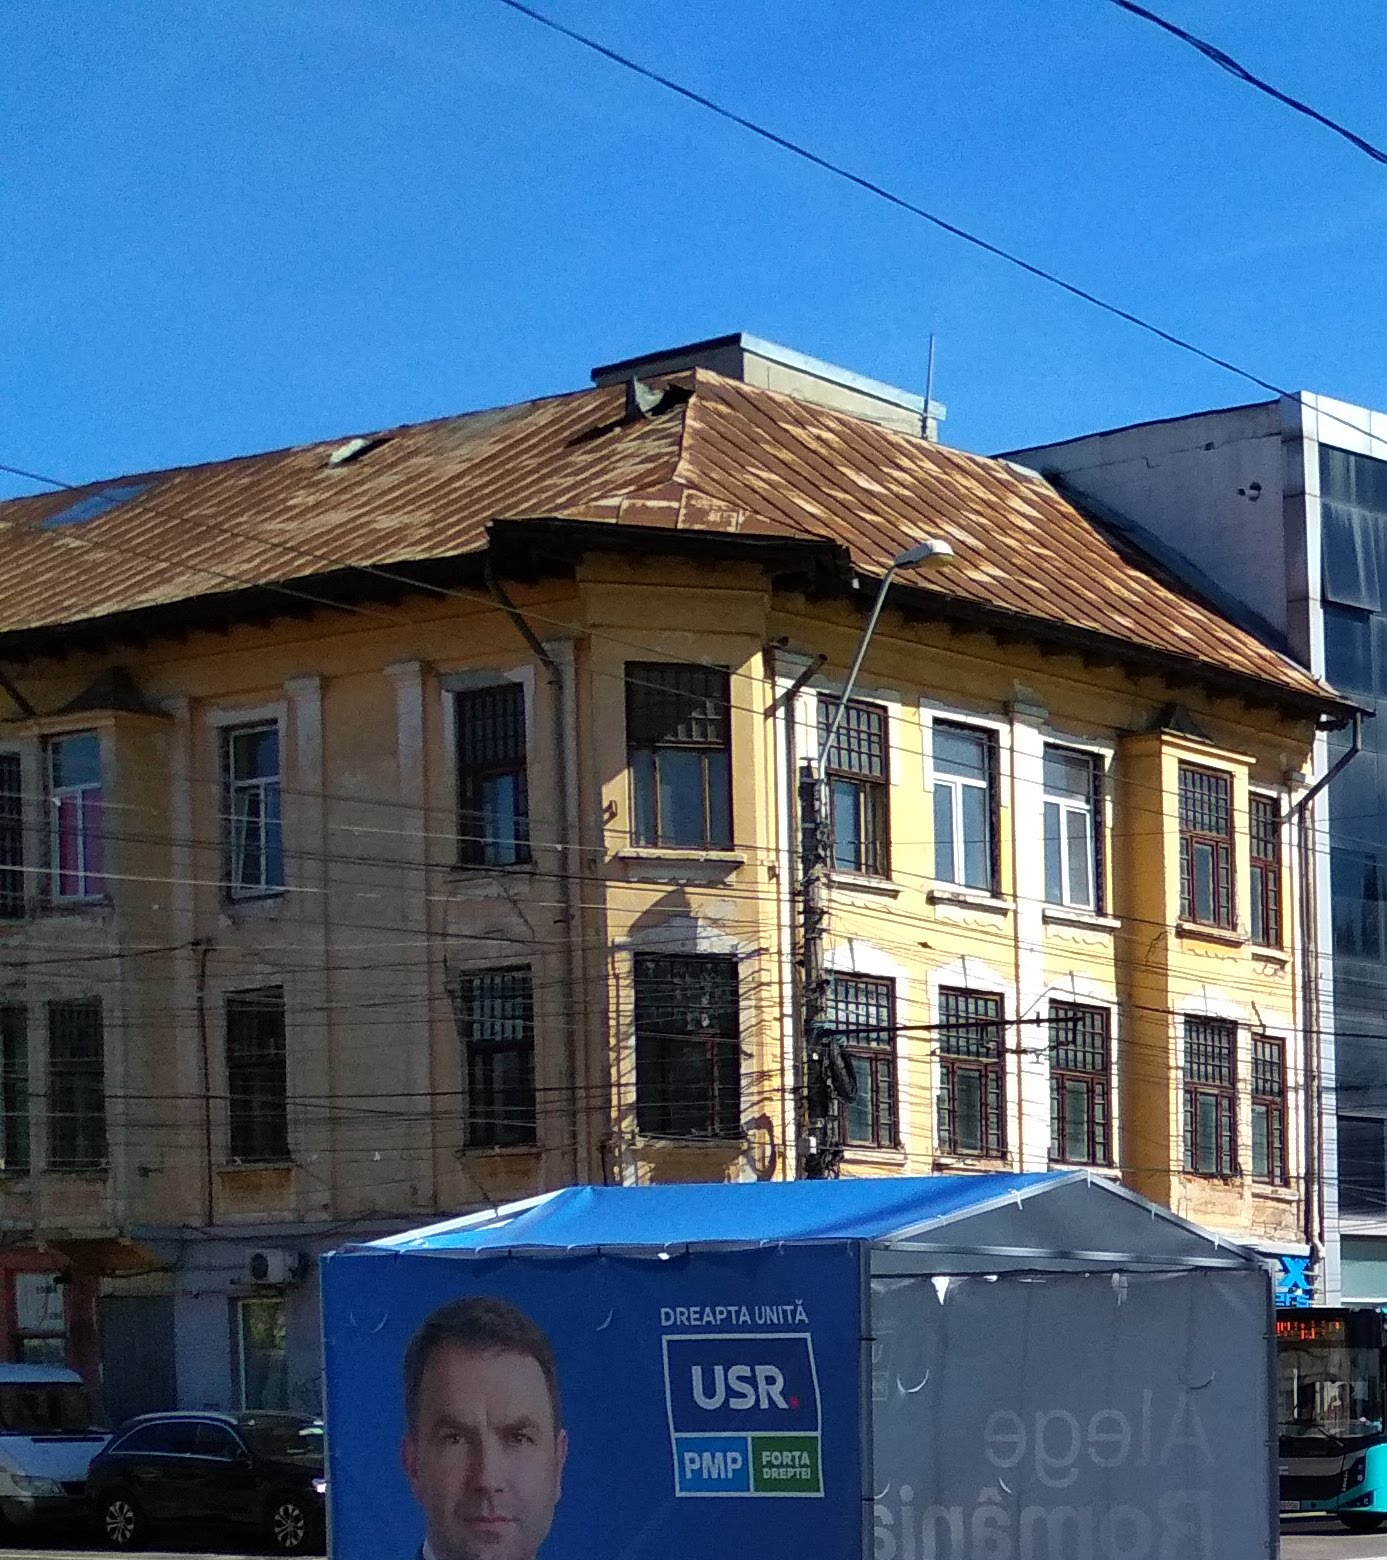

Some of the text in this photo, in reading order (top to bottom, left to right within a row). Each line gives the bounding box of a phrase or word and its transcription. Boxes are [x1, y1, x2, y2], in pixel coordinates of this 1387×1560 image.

[660, 1299, 809, 1326] DREAPTA UNITĂ
[684, 1451, 743, 1480] PMP
[763, 1468, 811, 1480] DREPTEI
